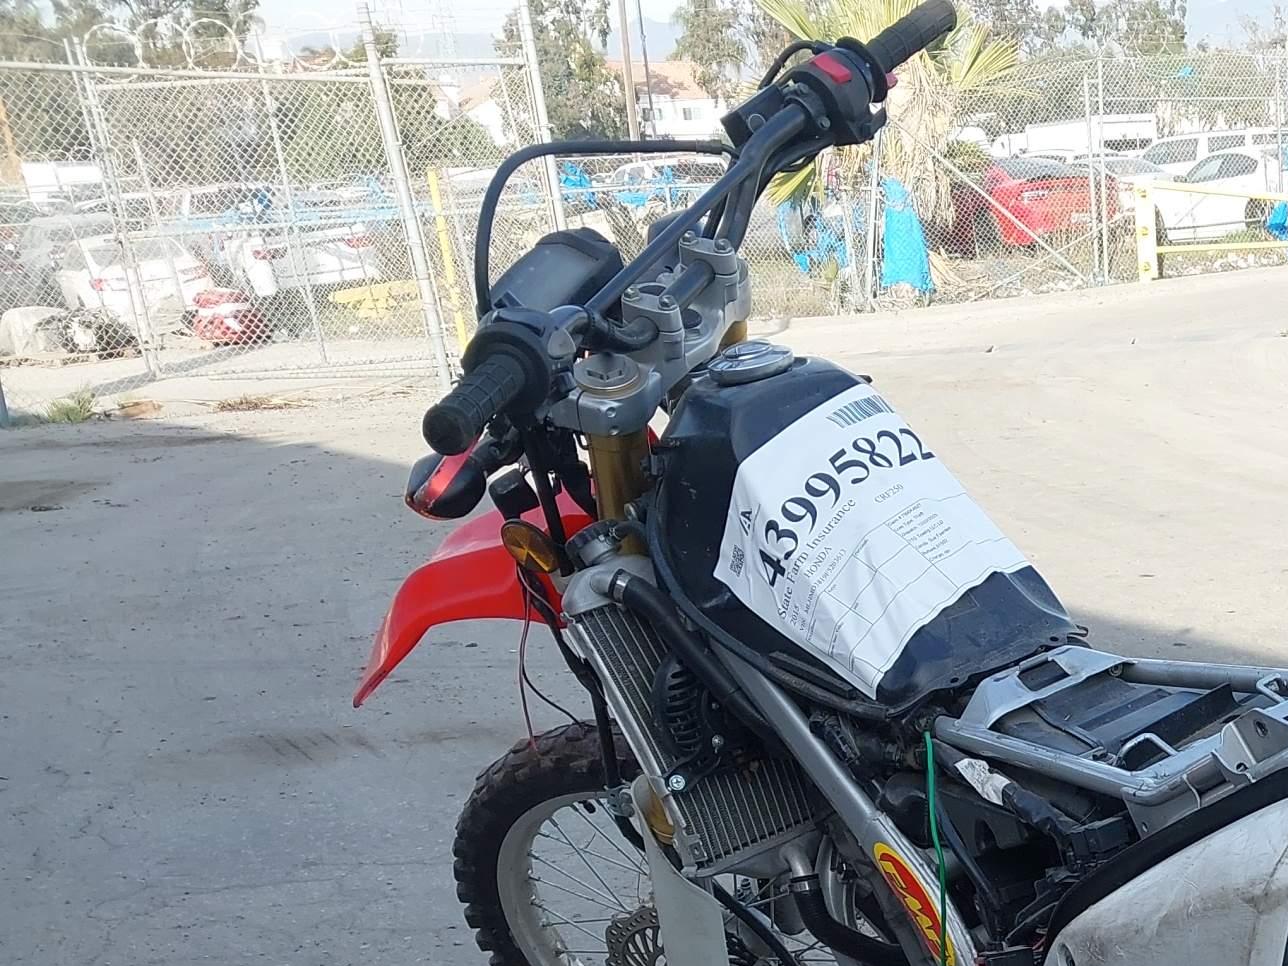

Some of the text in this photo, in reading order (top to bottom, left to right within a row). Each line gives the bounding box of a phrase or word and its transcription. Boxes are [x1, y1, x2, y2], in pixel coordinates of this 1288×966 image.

[758, 428, 935, 587] 43995822
[778, 499, 857, 620] State Farm Insurance
[790, 605, 800, 627] 2015
[804, 545, 833, 578] HONDA
